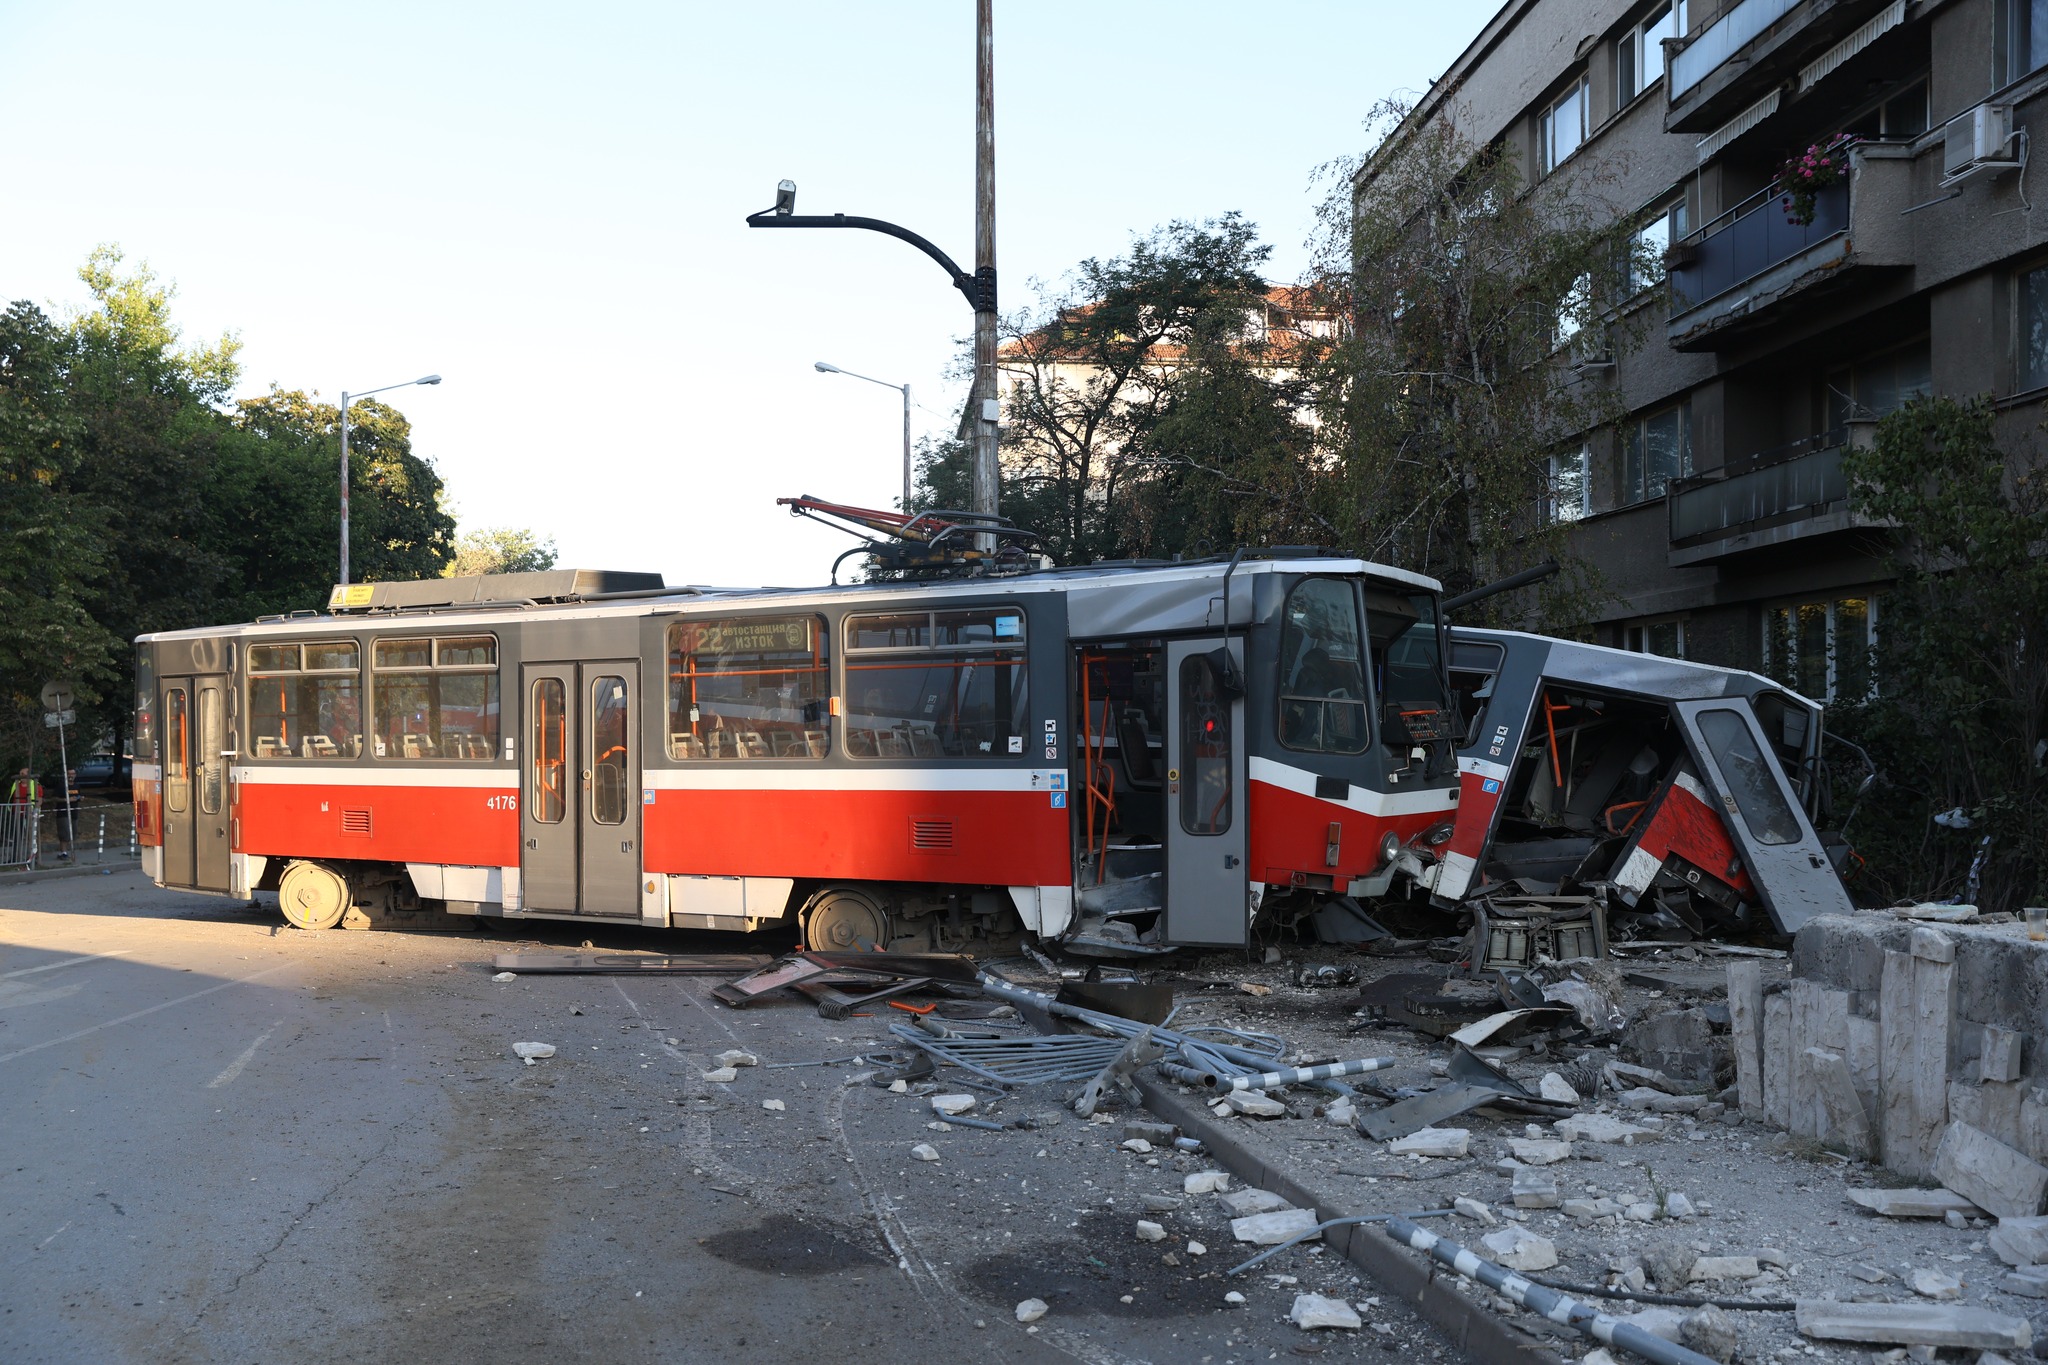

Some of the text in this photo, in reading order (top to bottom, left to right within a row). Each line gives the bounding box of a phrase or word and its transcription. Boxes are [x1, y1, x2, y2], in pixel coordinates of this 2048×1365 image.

[696, 627, 723, 652] 22
[735, 635, 774, 649] ИЗТОК
[487, 795, 517, 810] 4176
